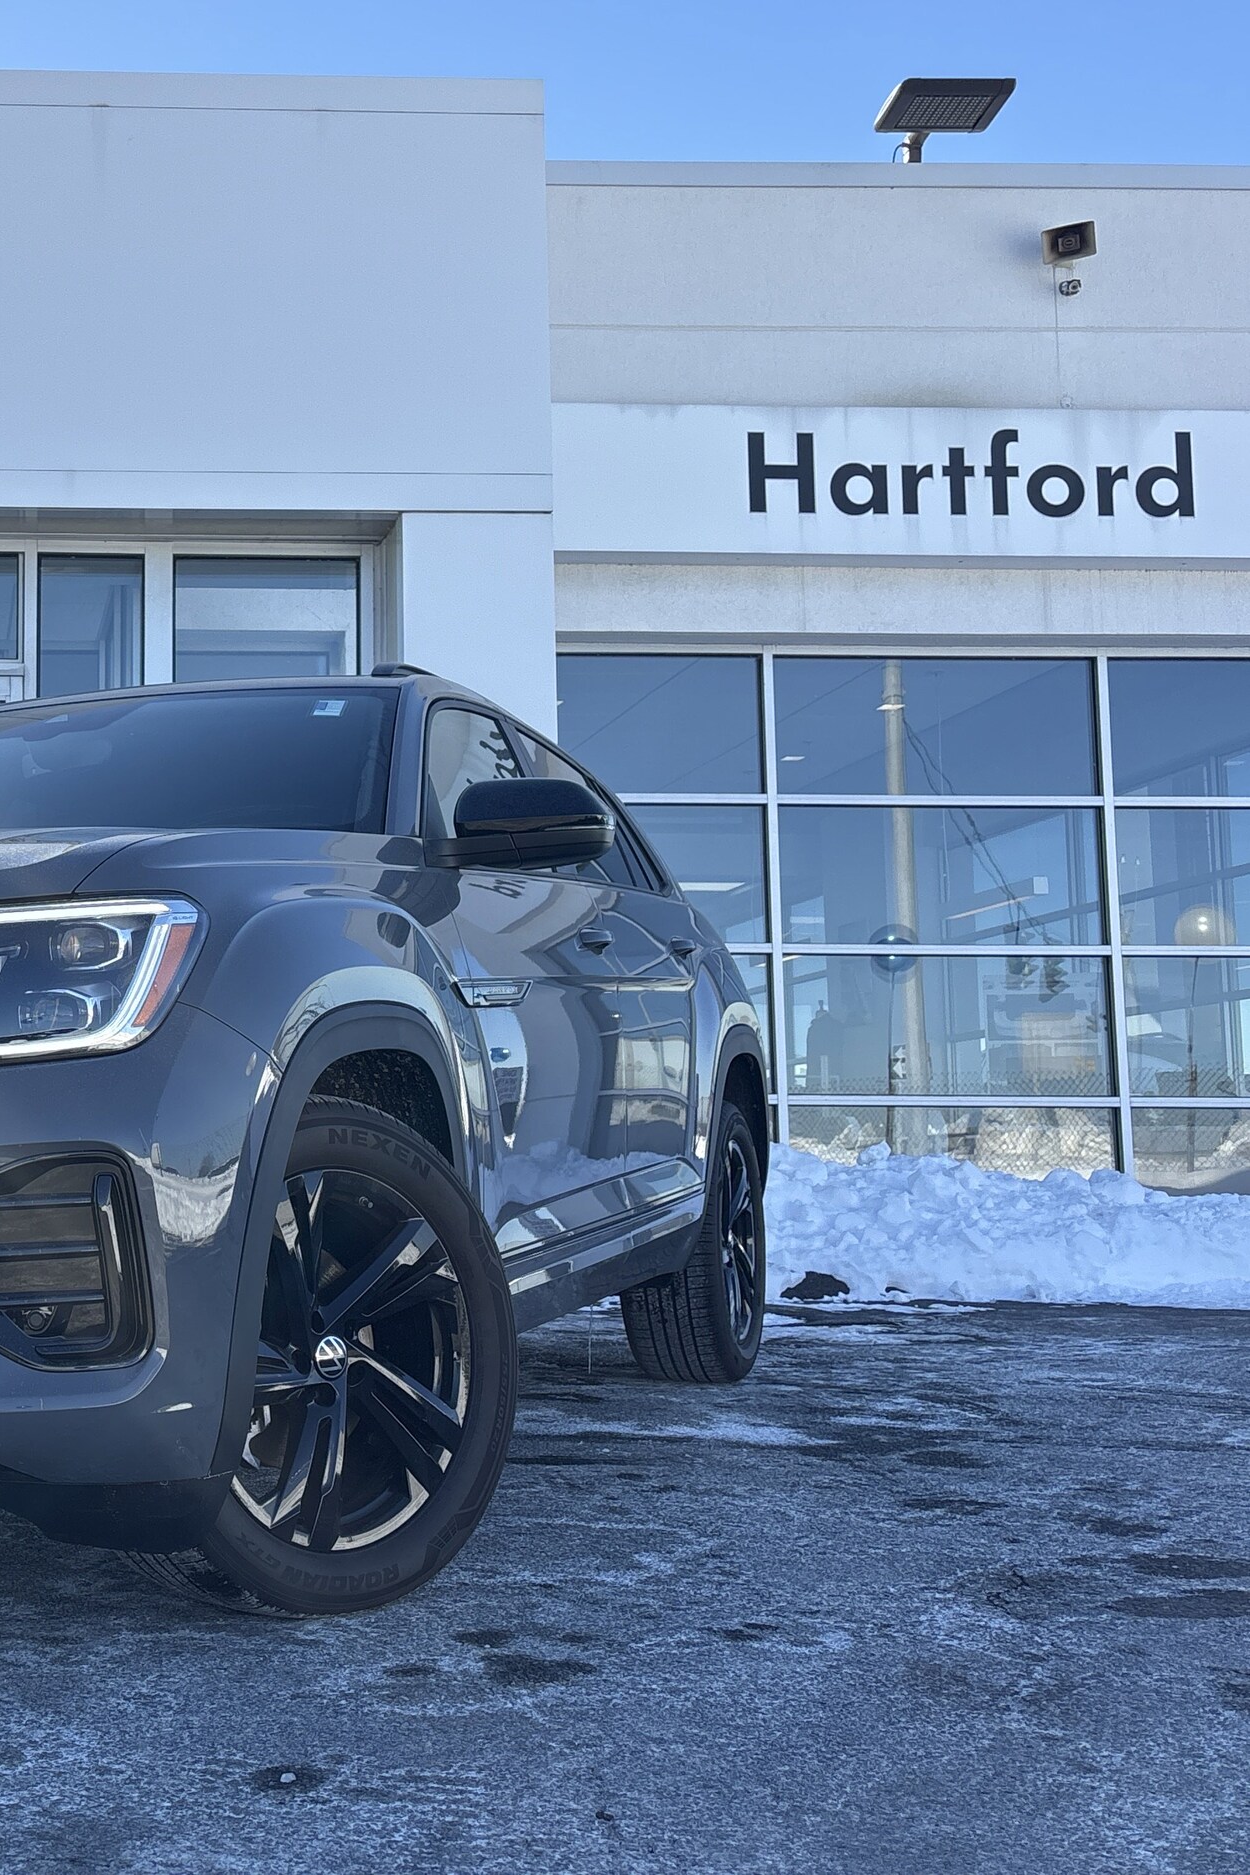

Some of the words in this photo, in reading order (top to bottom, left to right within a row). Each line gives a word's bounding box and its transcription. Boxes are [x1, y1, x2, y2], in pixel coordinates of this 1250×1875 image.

[747, 428, 1195, 518] Hartford
[328, 1128, 431, 1180] NEXEN
[279, 1563, 400, 1594] ROADIAN
